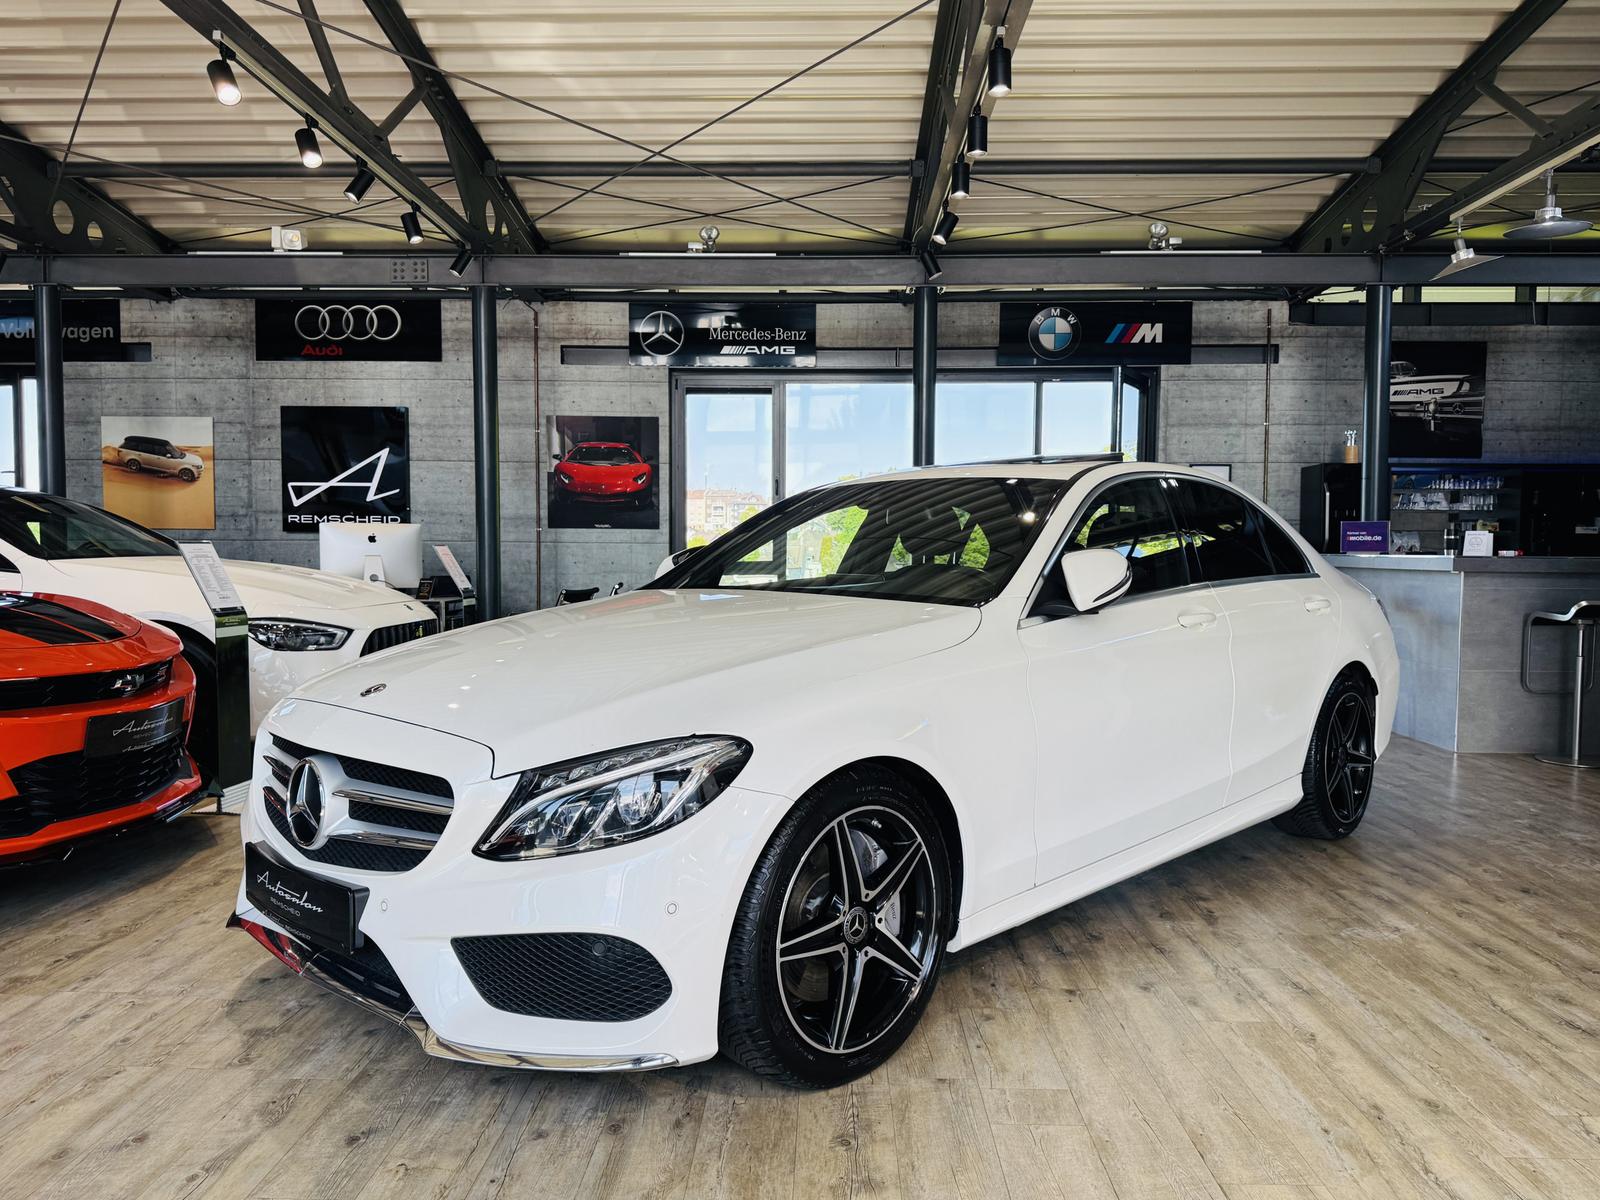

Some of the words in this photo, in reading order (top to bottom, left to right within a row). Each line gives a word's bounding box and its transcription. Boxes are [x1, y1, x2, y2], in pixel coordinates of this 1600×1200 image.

[1034, 308, 1077, 325] BMW
[0, 322, 114, 342] Volagen
[709, 328, 807, 341] Mercedes-Benz
[301, 344, 343, 356] Audi
[741, 346, 796, 355] AMG
[1405, 388, 1445, 396] AMG
[288, 514, 401, 524] REMSCHEID
[256, 871, 323, 913] Autosalon
